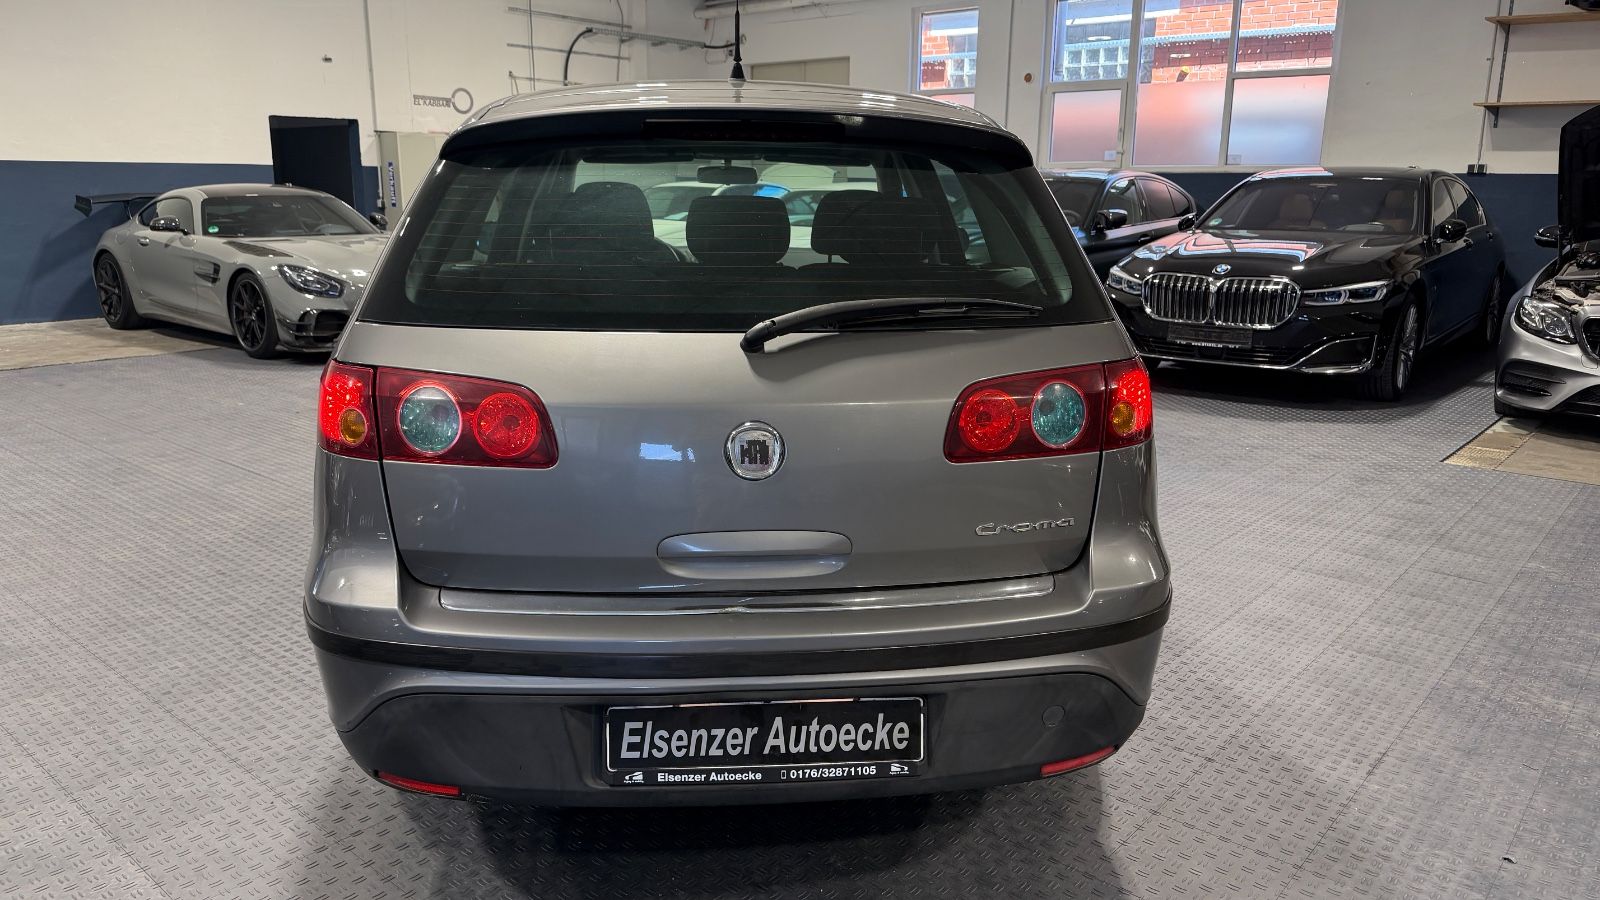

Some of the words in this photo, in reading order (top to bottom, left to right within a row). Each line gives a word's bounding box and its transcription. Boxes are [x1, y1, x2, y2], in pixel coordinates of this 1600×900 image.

[976, 518, 1075, 536] Croma
[620, 720, 758, 759] Elsenzer
[763, 713, 910, 756] Autoecke
[657, 772, 707, 782] Elsenzer
[709, 771, 763, 781] Autoecke
[790, 765, 877, 779] 0176/32871105
